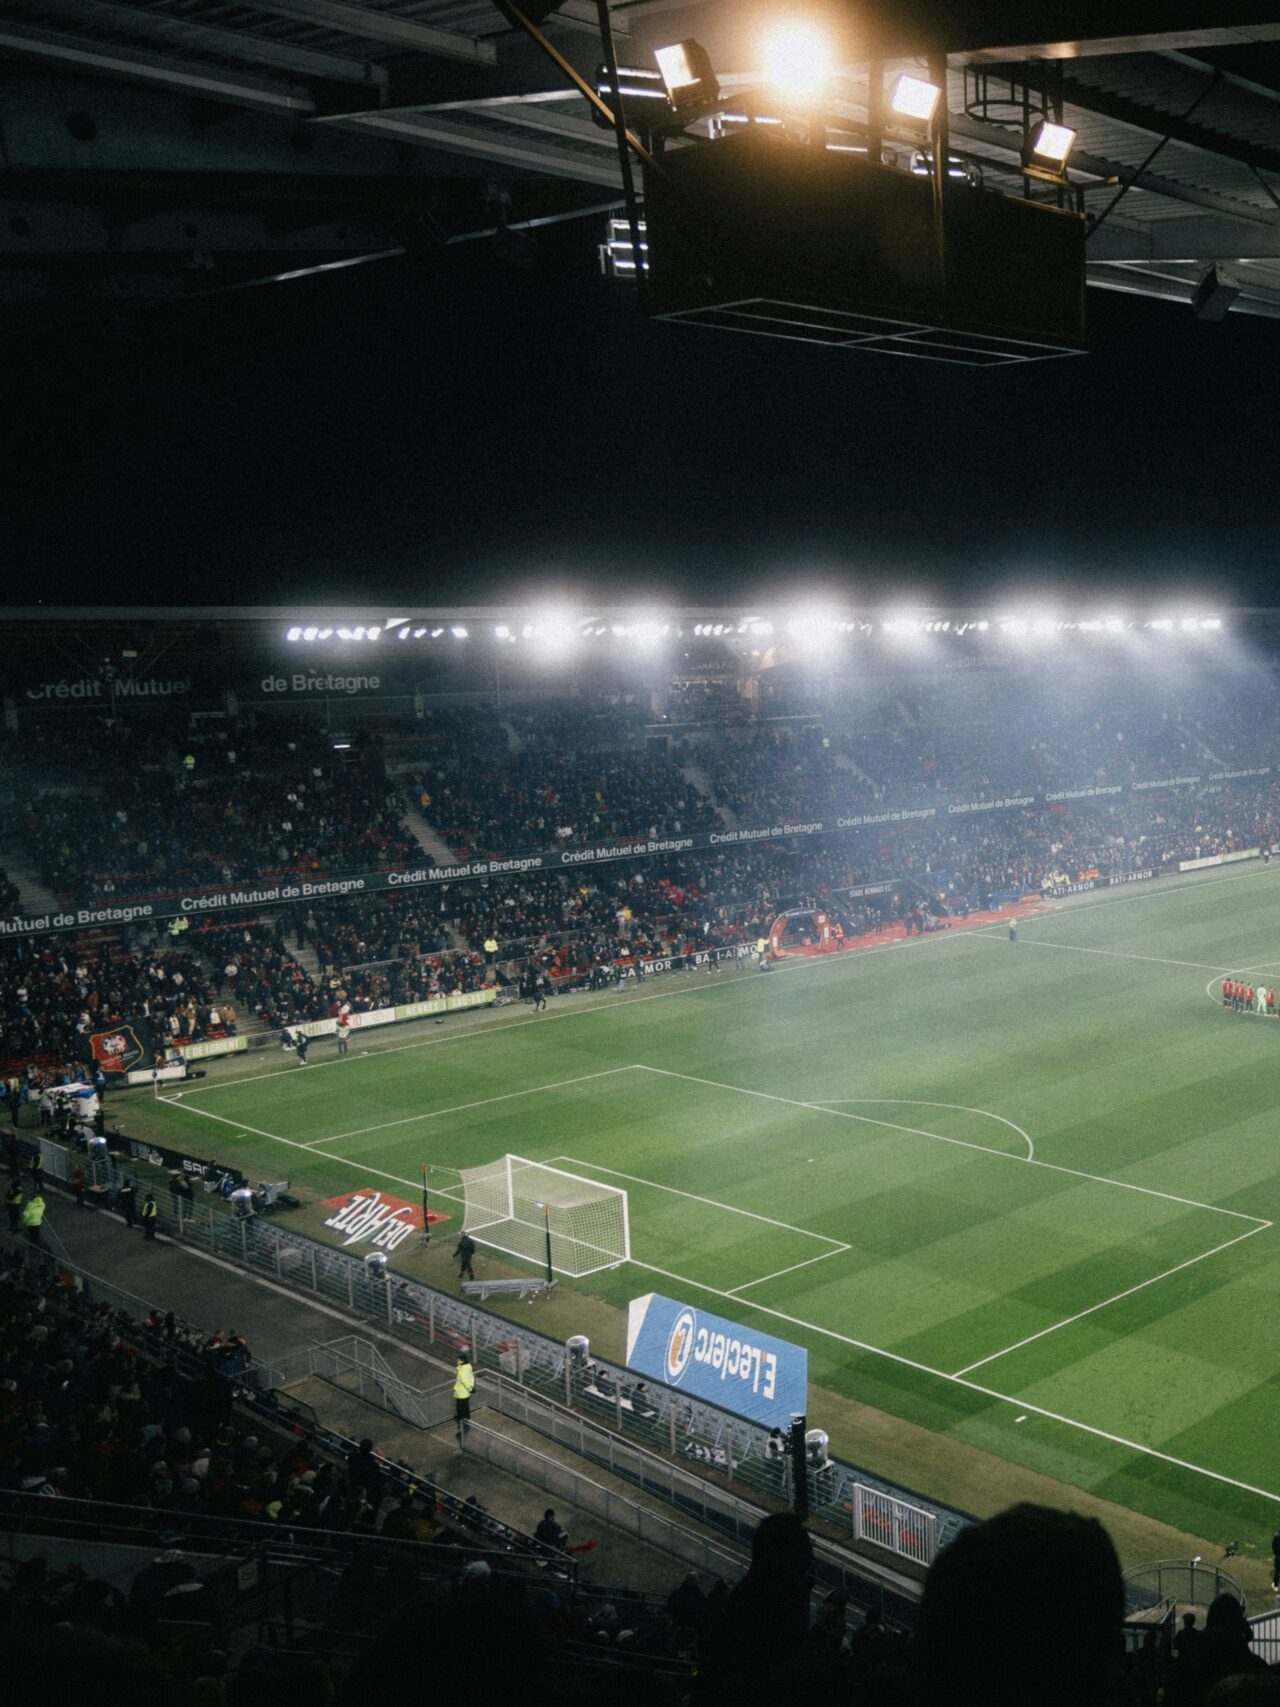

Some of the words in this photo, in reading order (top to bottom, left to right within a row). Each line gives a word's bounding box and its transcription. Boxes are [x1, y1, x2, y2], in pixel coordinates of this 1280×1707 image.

[115, 678, 192, 696] Mutuel
[262, 678, 287, 693] de
[293, 672, 381, 694] Bretagne
[837, 815, 862, 828] Crédit
[863, 811, 890, 825] Mutuel
[890, 809, 901, 822] de
[901, 807, 936, 821] Bretagne
[948, 802, 970, 815] Crédit
[970, 799, 994, 812] Mutuel
[994, 798, 1004, 809] de
[1004, 795, 1035, 809] Bretagne
[709, 831, 738, 845] Crédit
[739, 826, 770, 842] Mutuel
[771, 823, 783, 837] de
[783, 820, 823, 836] Bretagne
[561, 850, 594, 864] Crédit
[595, 845, 631, 861] Mutuel
[632, 843, 646, 856] de
[647, 838, 693, 854] Bretagne
[388, 870, 427, 886] Crédit
[428, 865, 470, 883] Mutuel
[472, 862, 488, 876] de
[489, 857, 542, 875] Bretagne
[1110, 870, 1153, 885] BATI-ARMOR
[181, 895, 228, 912] Crédit
[229, 889, 279, 907] Mutuel
[282, 886, 299, 900] de
[302, 878, 365, 898] Bretagne
[1053, 881, 1095, 896] ATI-ARMOR
[0, 916, 50, 934] Mutuel
[53, 913, 75, 927] de
[77, 905, 153, 924] Bretagne
[694, 1328, 777, 1400] E.Leclerc
